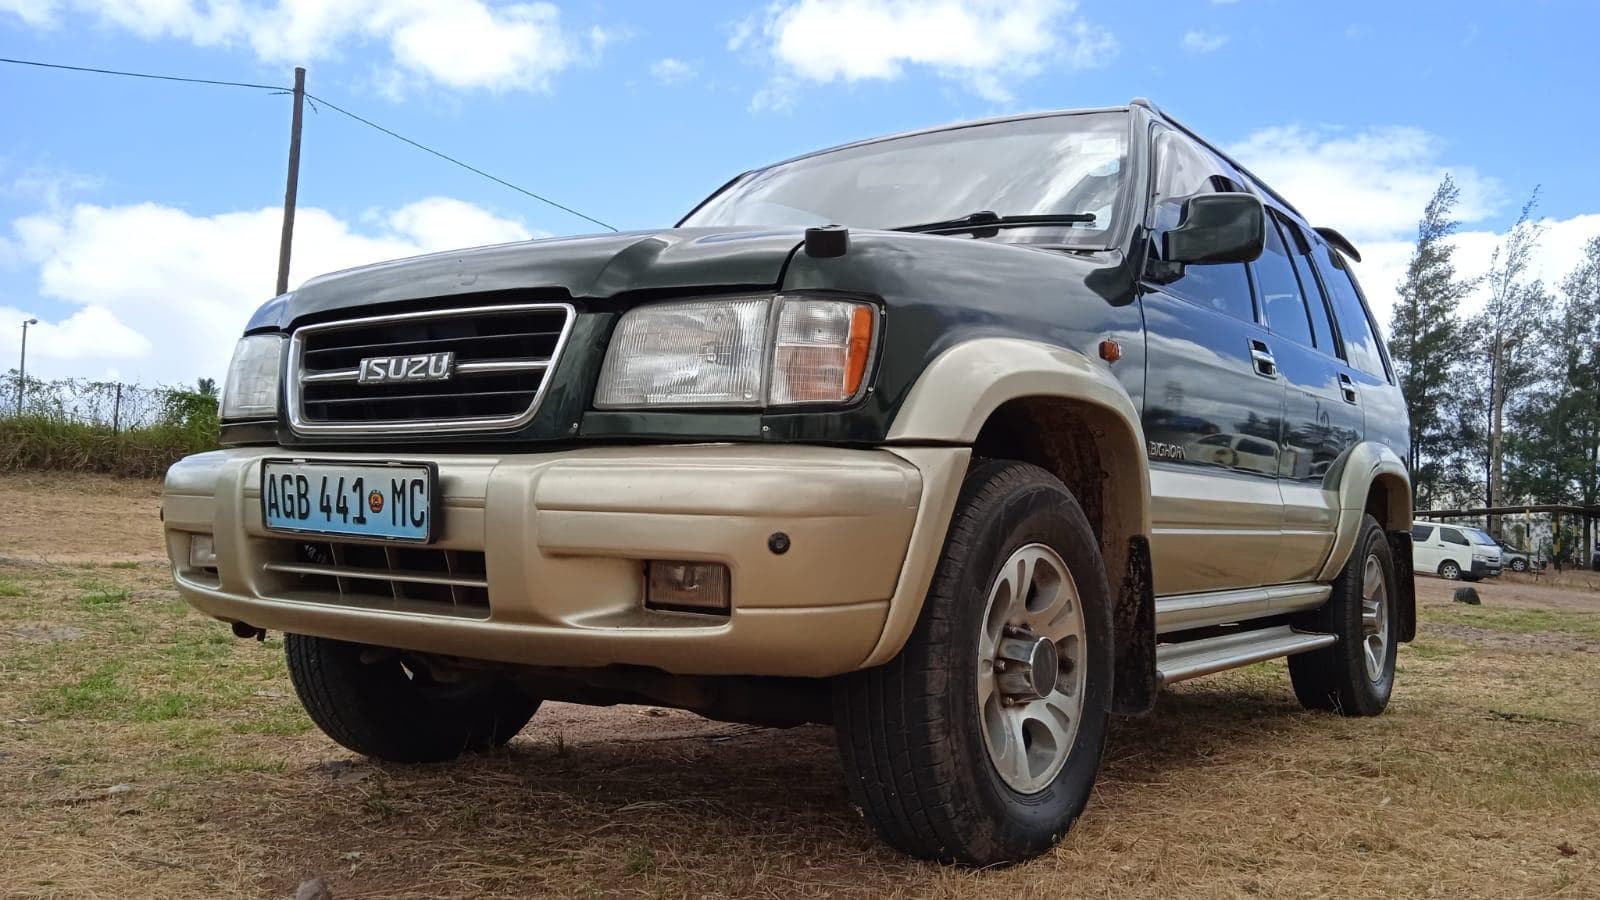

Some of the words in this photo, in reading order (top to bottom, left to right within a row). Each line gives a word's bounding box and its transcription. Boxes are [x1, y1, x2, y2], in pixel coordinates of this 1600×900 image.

[359, 354, 449, 382] ISUZU
[268, 474, 310, 520] AGB
[319, 476, 367, 524] 441
[391, 478, 425, 528] MC
